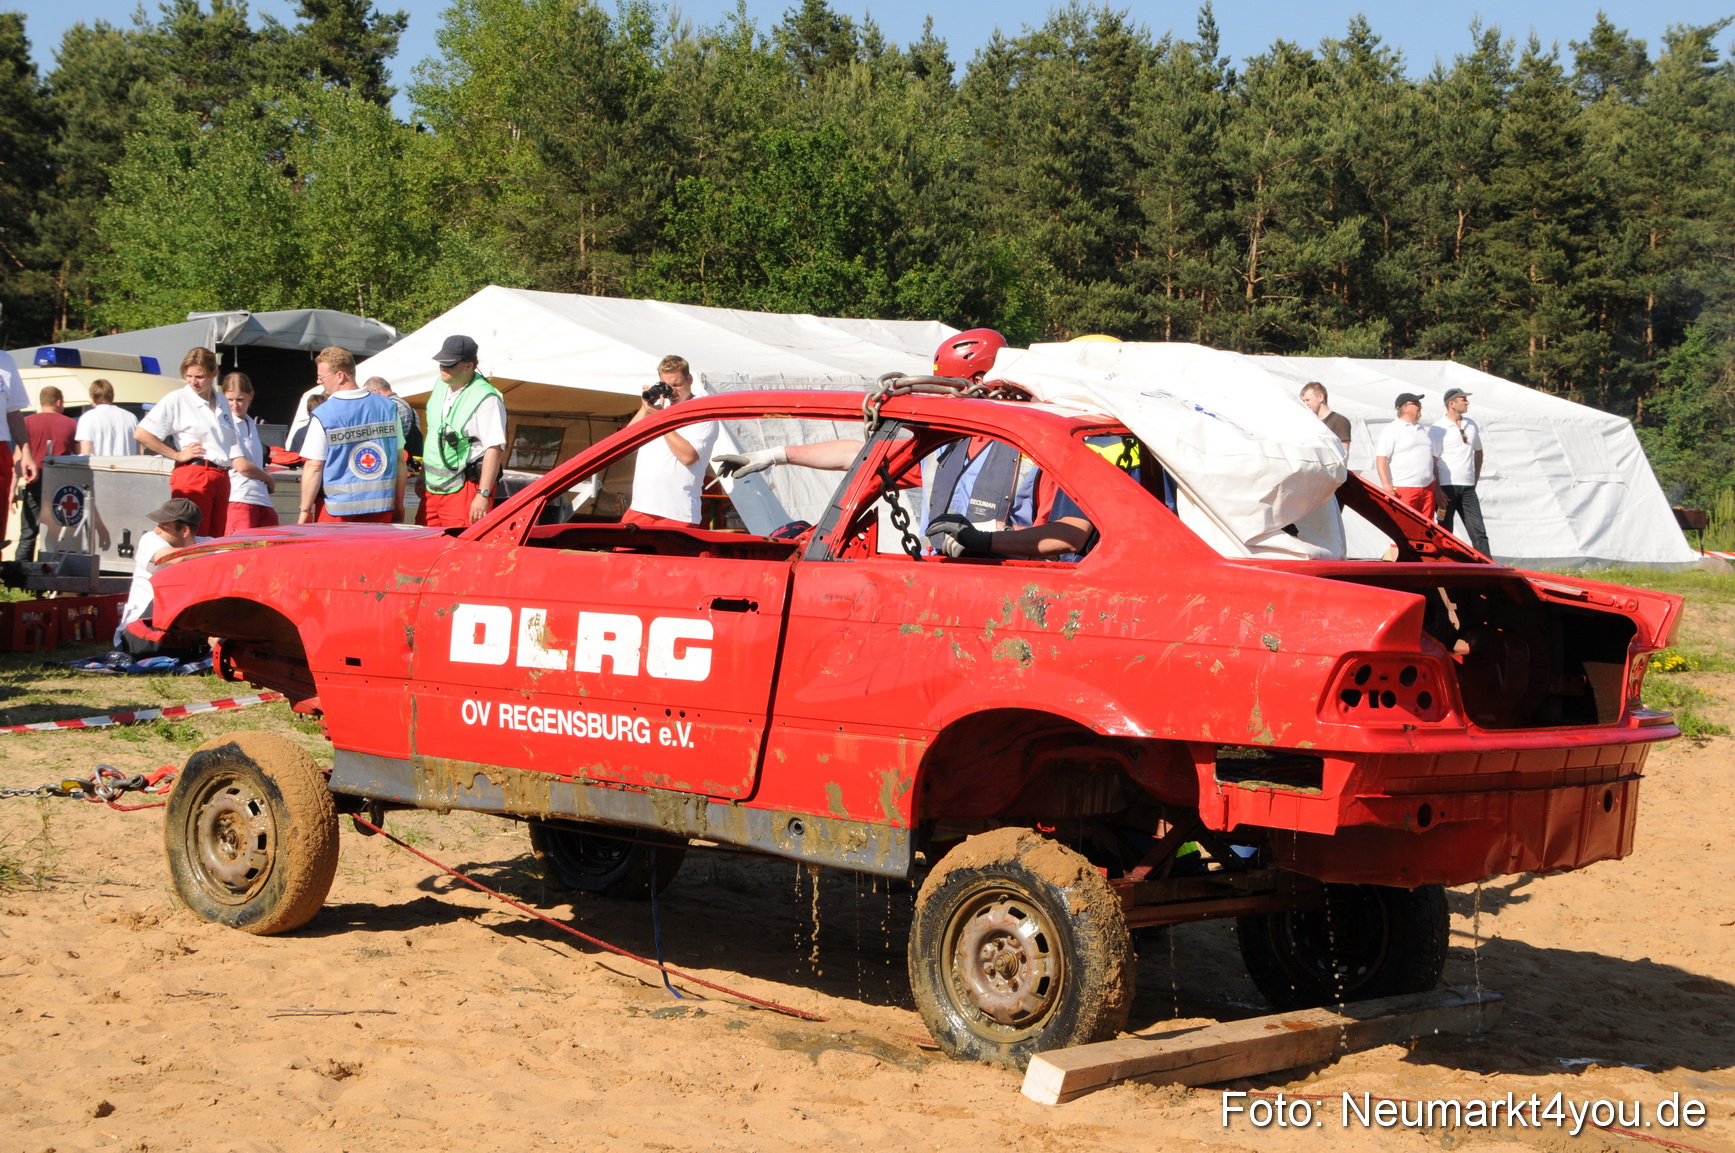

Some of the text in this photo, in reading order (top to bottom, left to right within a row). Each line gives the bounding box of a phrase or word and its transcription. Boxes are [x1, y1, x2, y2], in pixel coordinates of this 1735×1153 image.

[330, 425, 395, 442] BOOTSFÜHRER
[970, 498, 996, 509] SECUMAR
[449, 603, 714, 681] DLRG
[461, 699, 695, 748] OV REGENSBURG e.V.
